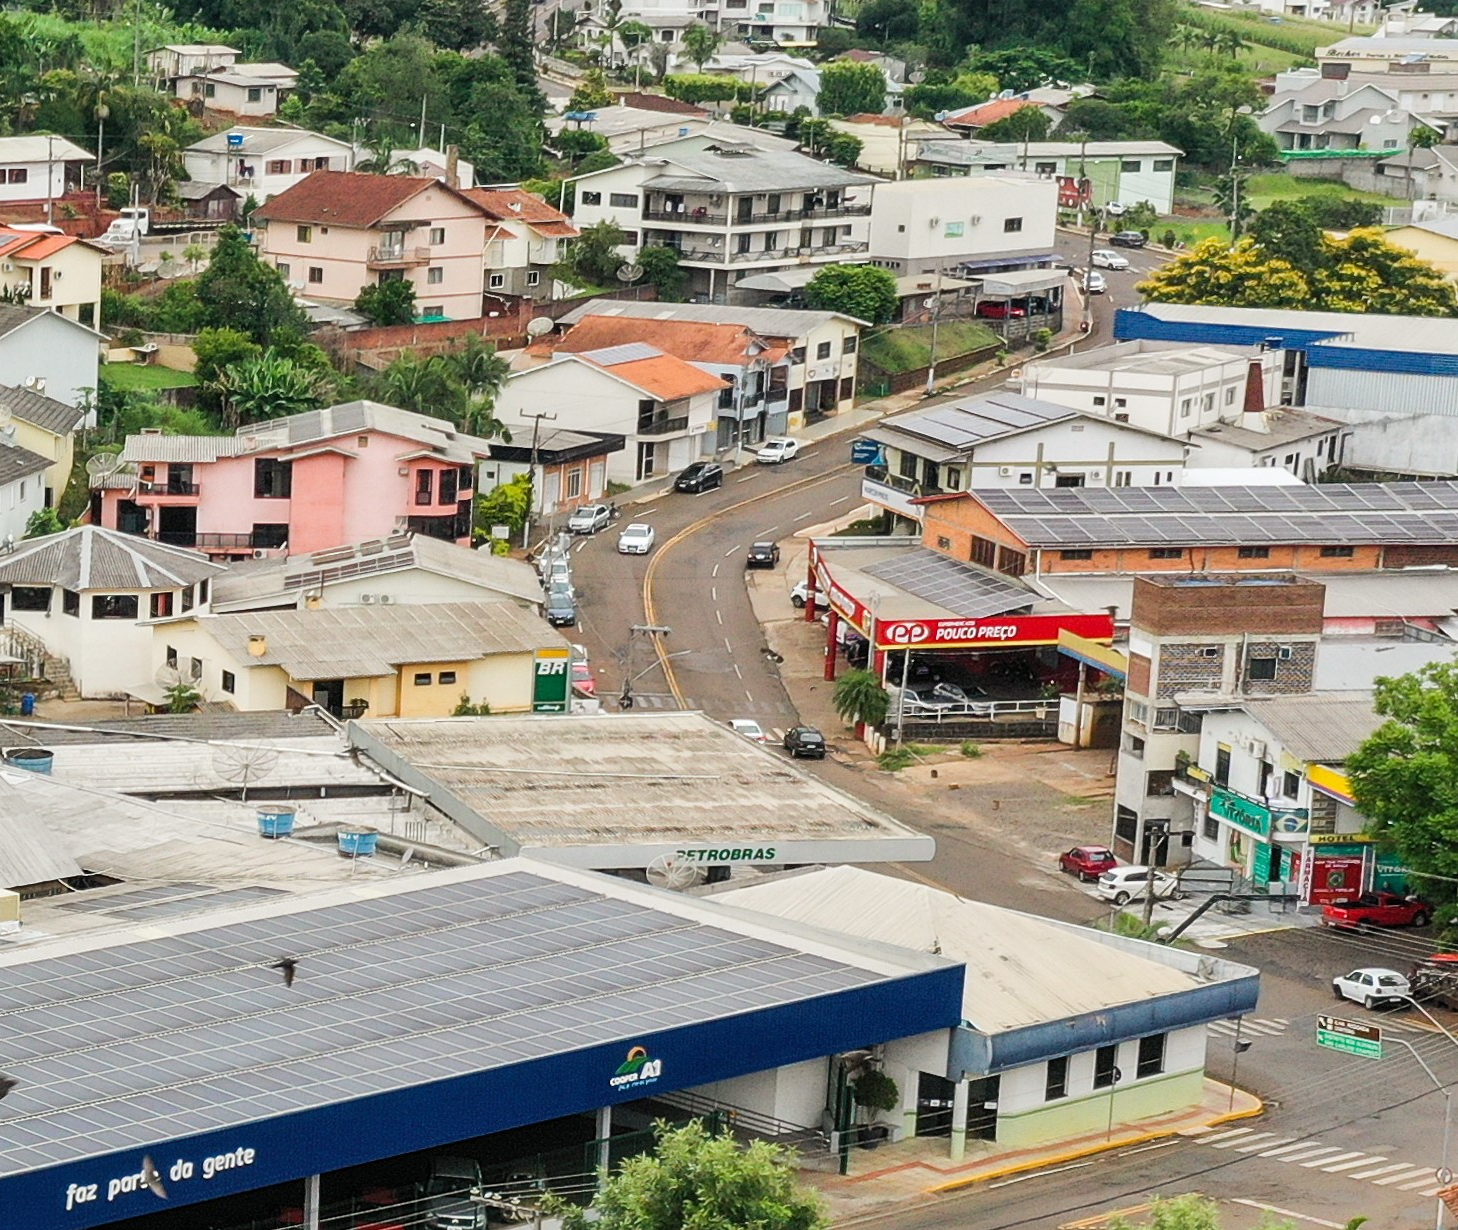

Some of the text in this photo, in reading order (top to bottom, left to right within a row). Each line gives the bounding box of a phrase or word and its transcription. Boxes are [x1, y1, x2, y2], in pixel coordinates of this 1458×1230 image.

[936, 625, 1017, 641] POUCO PREÇO
[537, 662, 565, 675] BR
[640, 1059, 662, 1079] A1
[66, 1184, 99, 1211] faz
[170, 1159, 194, 1182] da
[203, 1147, 256, 1179] gente
